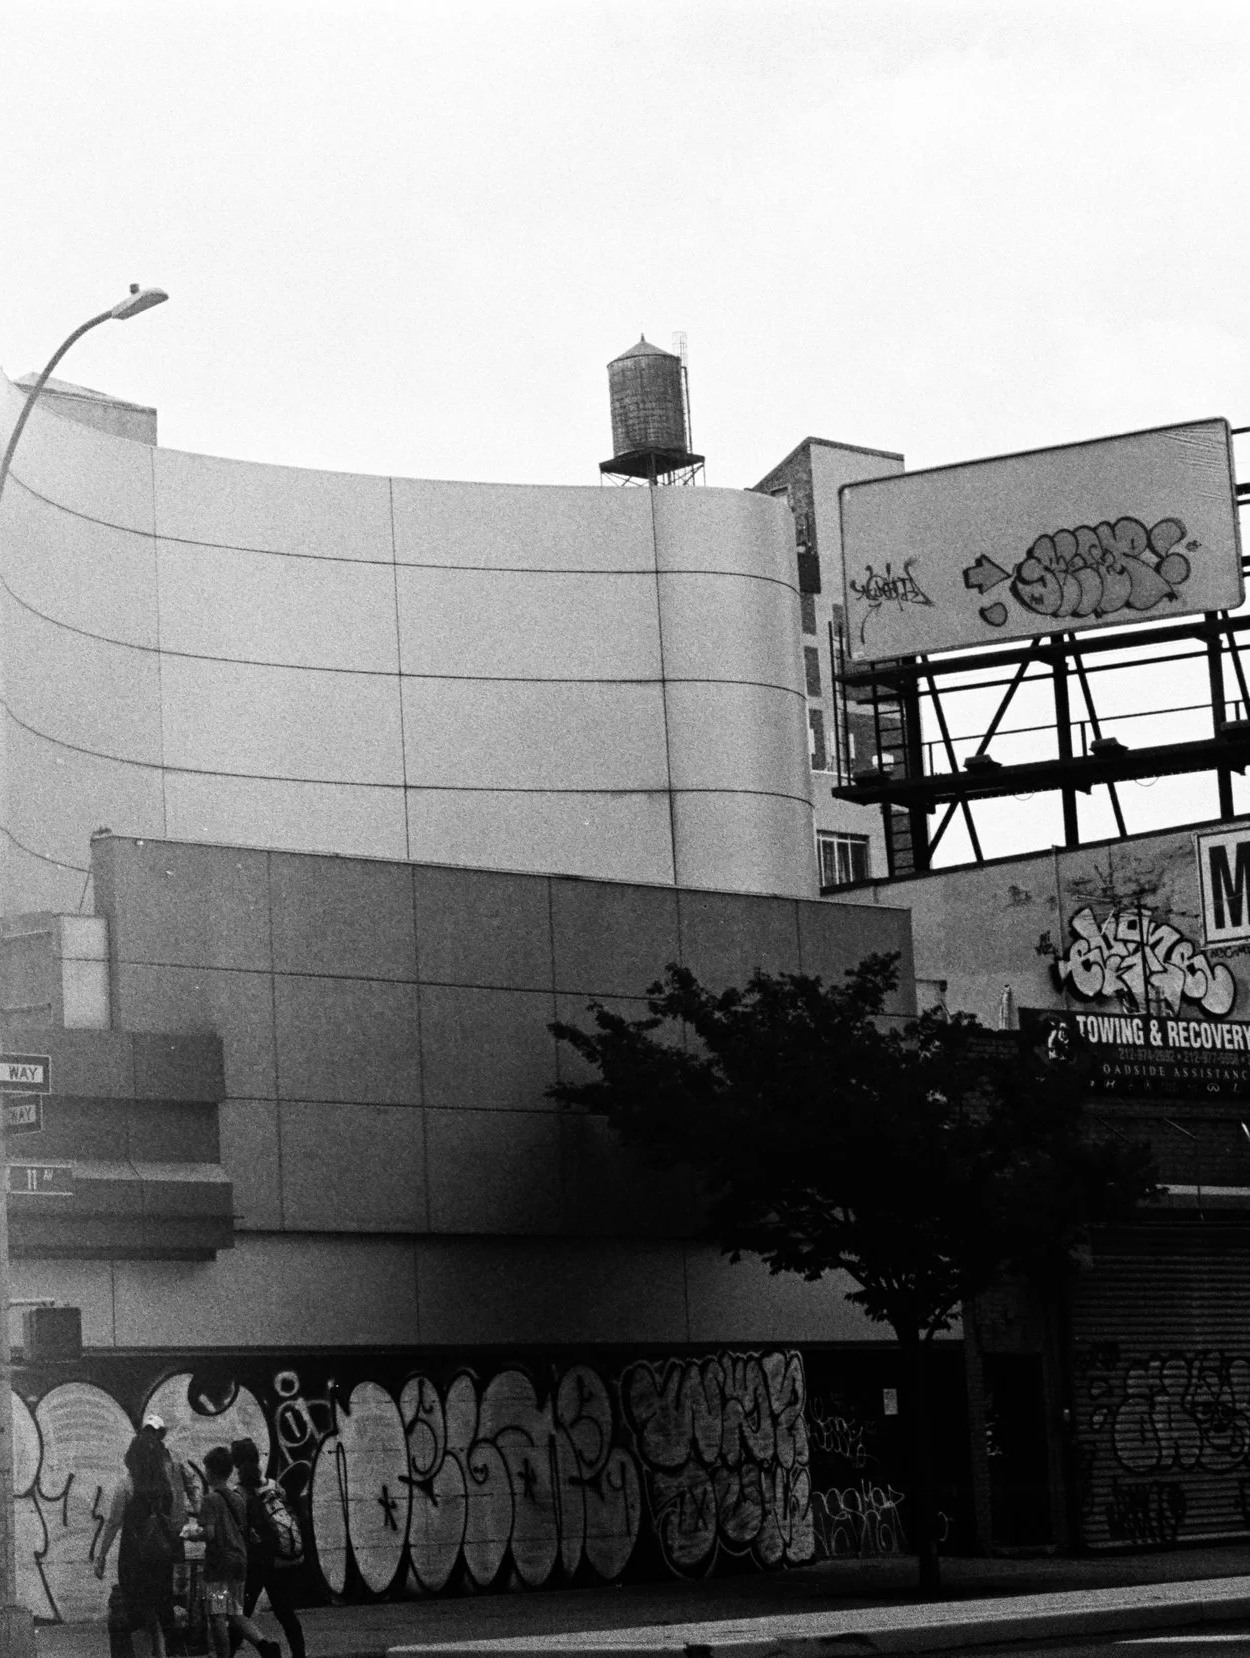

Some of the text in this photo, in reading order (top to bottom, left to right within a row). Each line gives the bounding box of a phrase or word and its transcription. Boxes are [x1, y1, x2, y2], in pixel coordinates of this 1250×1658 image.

[1076, 1015, 1145, 1047] TOWING
[1149, 1020, 1163, 1047] &
[8, 1066, 38, 1081] WAY
[1102, 1063, 1167, 1077] OADSIDE
[27, 1168, 37, 1190] 11
